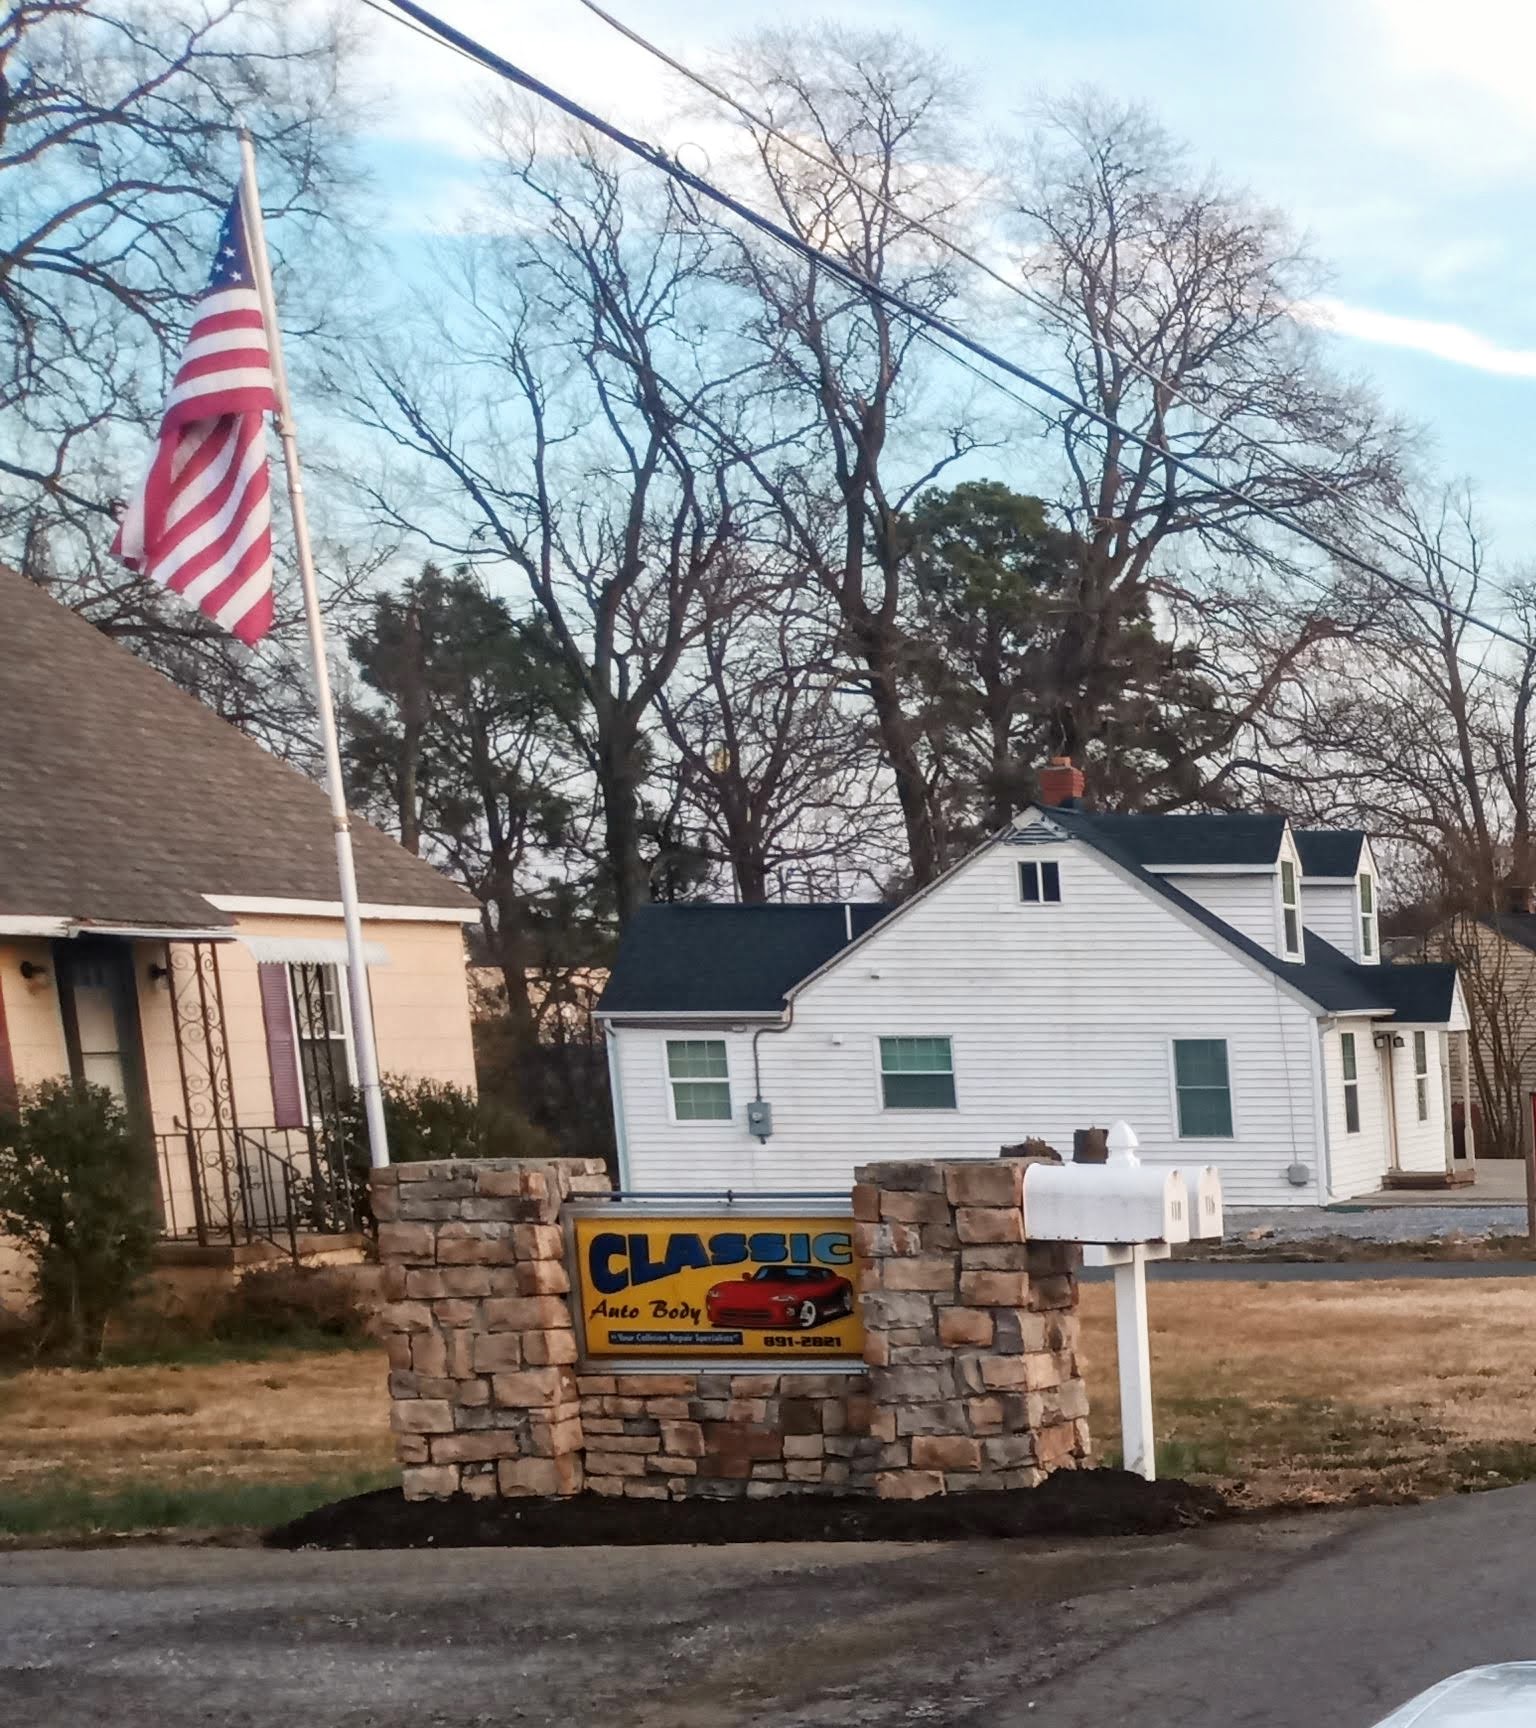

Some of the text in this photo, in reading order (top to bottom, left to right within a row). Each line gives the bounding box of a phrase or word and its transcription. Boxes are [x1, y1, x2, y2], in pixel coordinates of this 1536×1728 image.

[588, 1232, 853, 1294] CLASSIC
[588, 1299, 702, 1326] Auto Body
[636, 1333, 668, 1342] Collision
[669, 1334, 693, 1343] Repair
